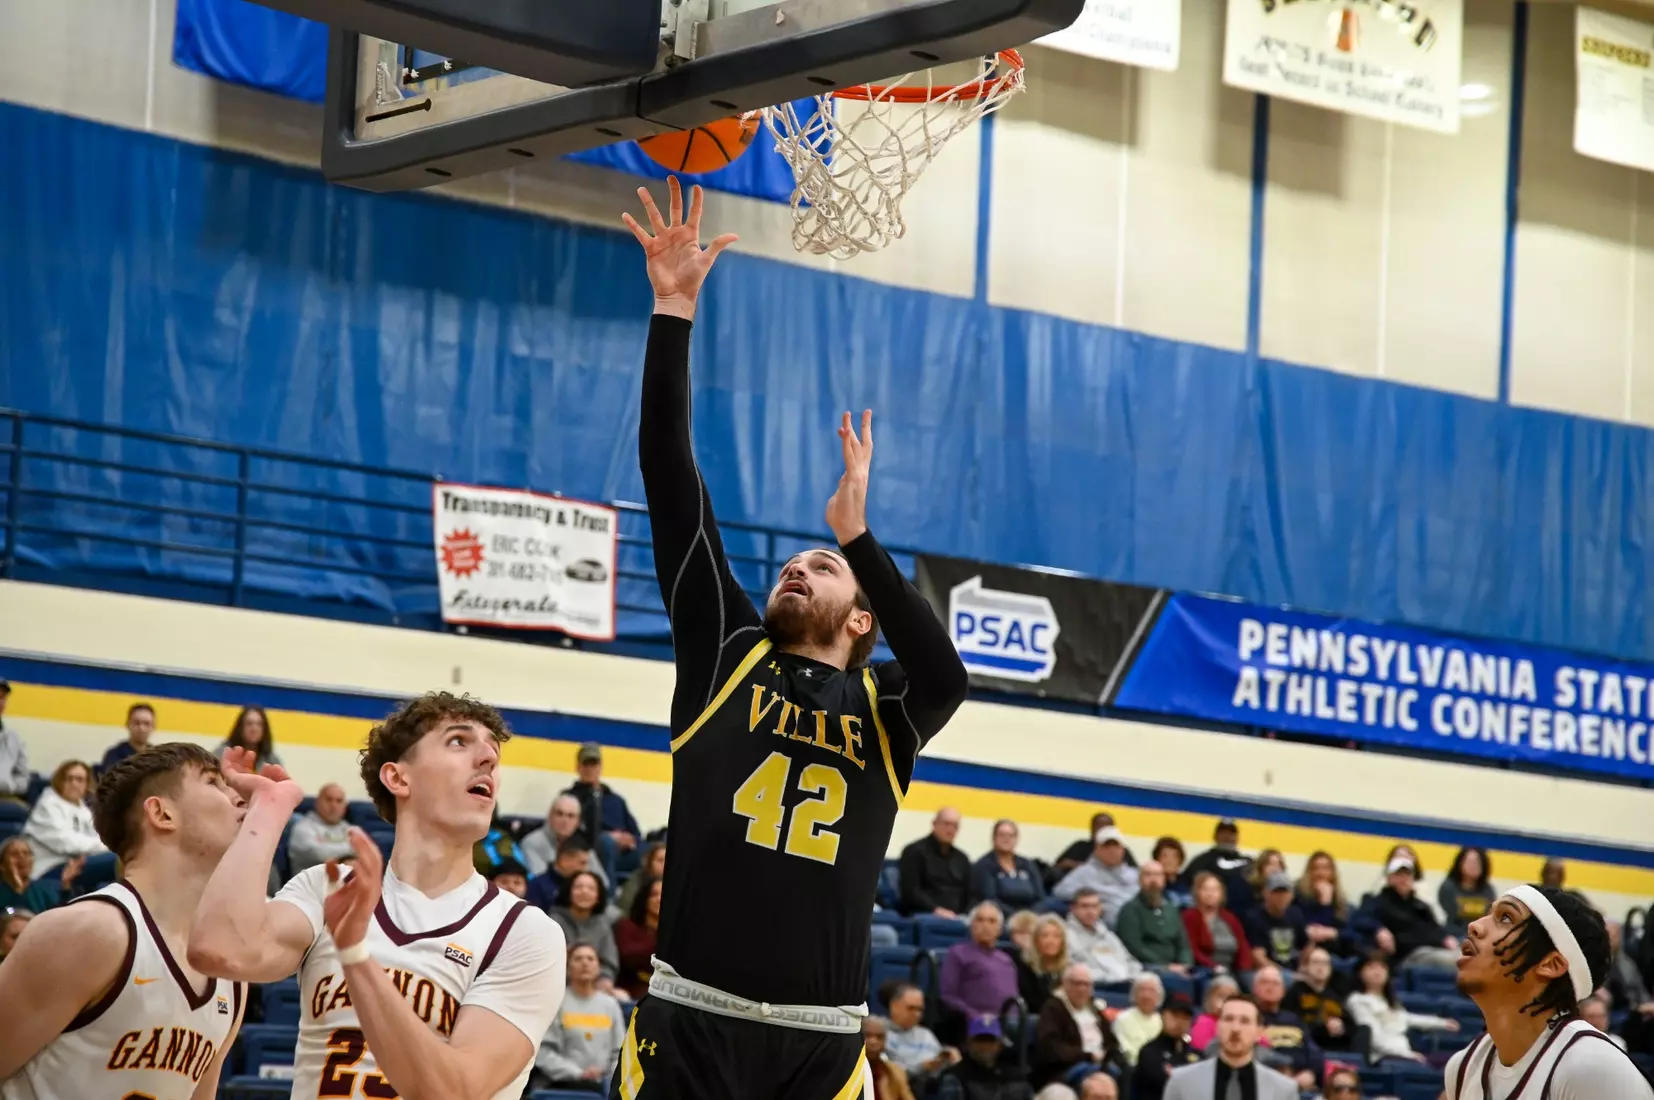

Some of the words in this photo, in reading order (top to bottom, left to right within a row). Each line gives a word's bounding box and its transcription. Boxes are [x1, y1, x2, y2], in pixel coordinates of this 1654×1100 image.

[442, 492, 550, 523] Transparency
[956, 612, 1048, 654] PSAC
[1238, 618, 1537, 702] PENNSYLVANIA
[749, 683, 866, 770] VILLE
[1233, 665, 1419, 732] ATHLETIC
[733, 751, 847, 866] 42
[445, 946, 473, 965] PSAC
[312, 967, 461, 1038] GANON
[107, 1026, 216, 1082] GANNO
